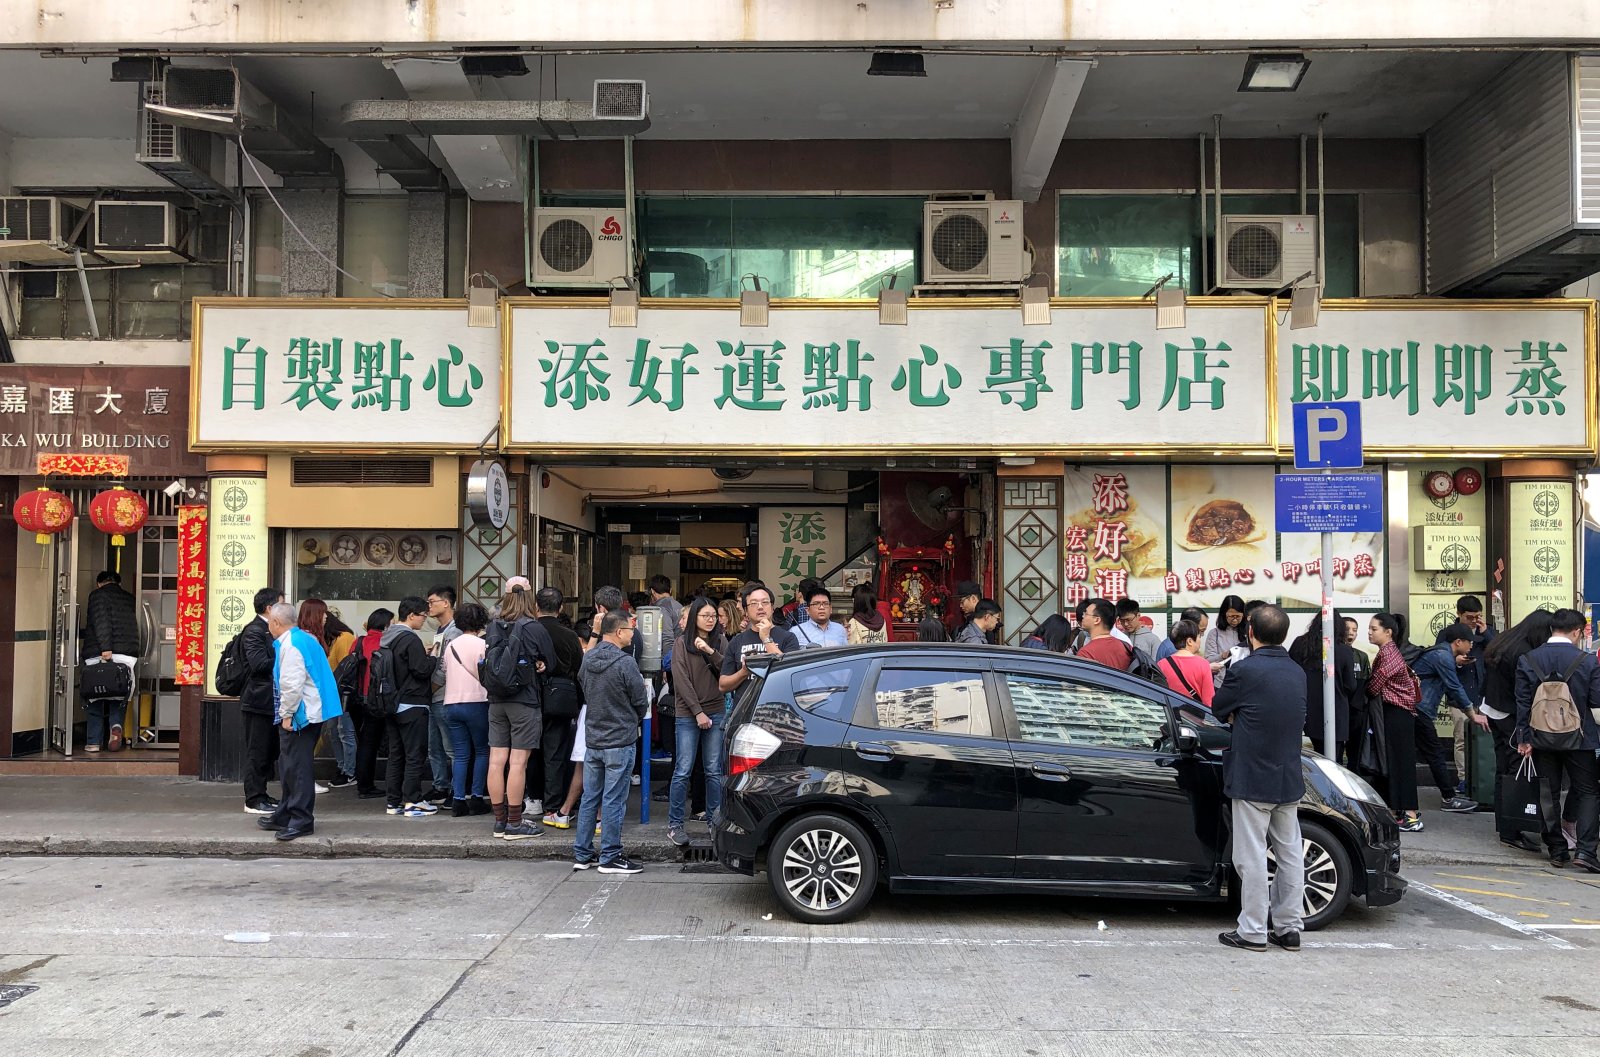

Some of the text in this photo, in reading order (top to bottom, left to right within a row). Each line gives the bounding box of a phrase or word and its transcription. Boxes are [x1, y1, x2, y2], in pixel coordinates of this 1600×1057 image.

[0, 385, 170, 415] 嘉匯大廈
[222, 336, 484, 411] 自製點心
[537, 337, 1233, 412] 添好運點心專門店
[1289, 340, 1568, 416] 即叫即蒸
[1, 433, 170, 449] KA WUI BUILDING
[57, 456, 109, 472] 出入平安
[1306, 408, 1348, 463] P
[777, 511, 827, 606] 添好
[1092, 473, 1128, 602] 添好運
